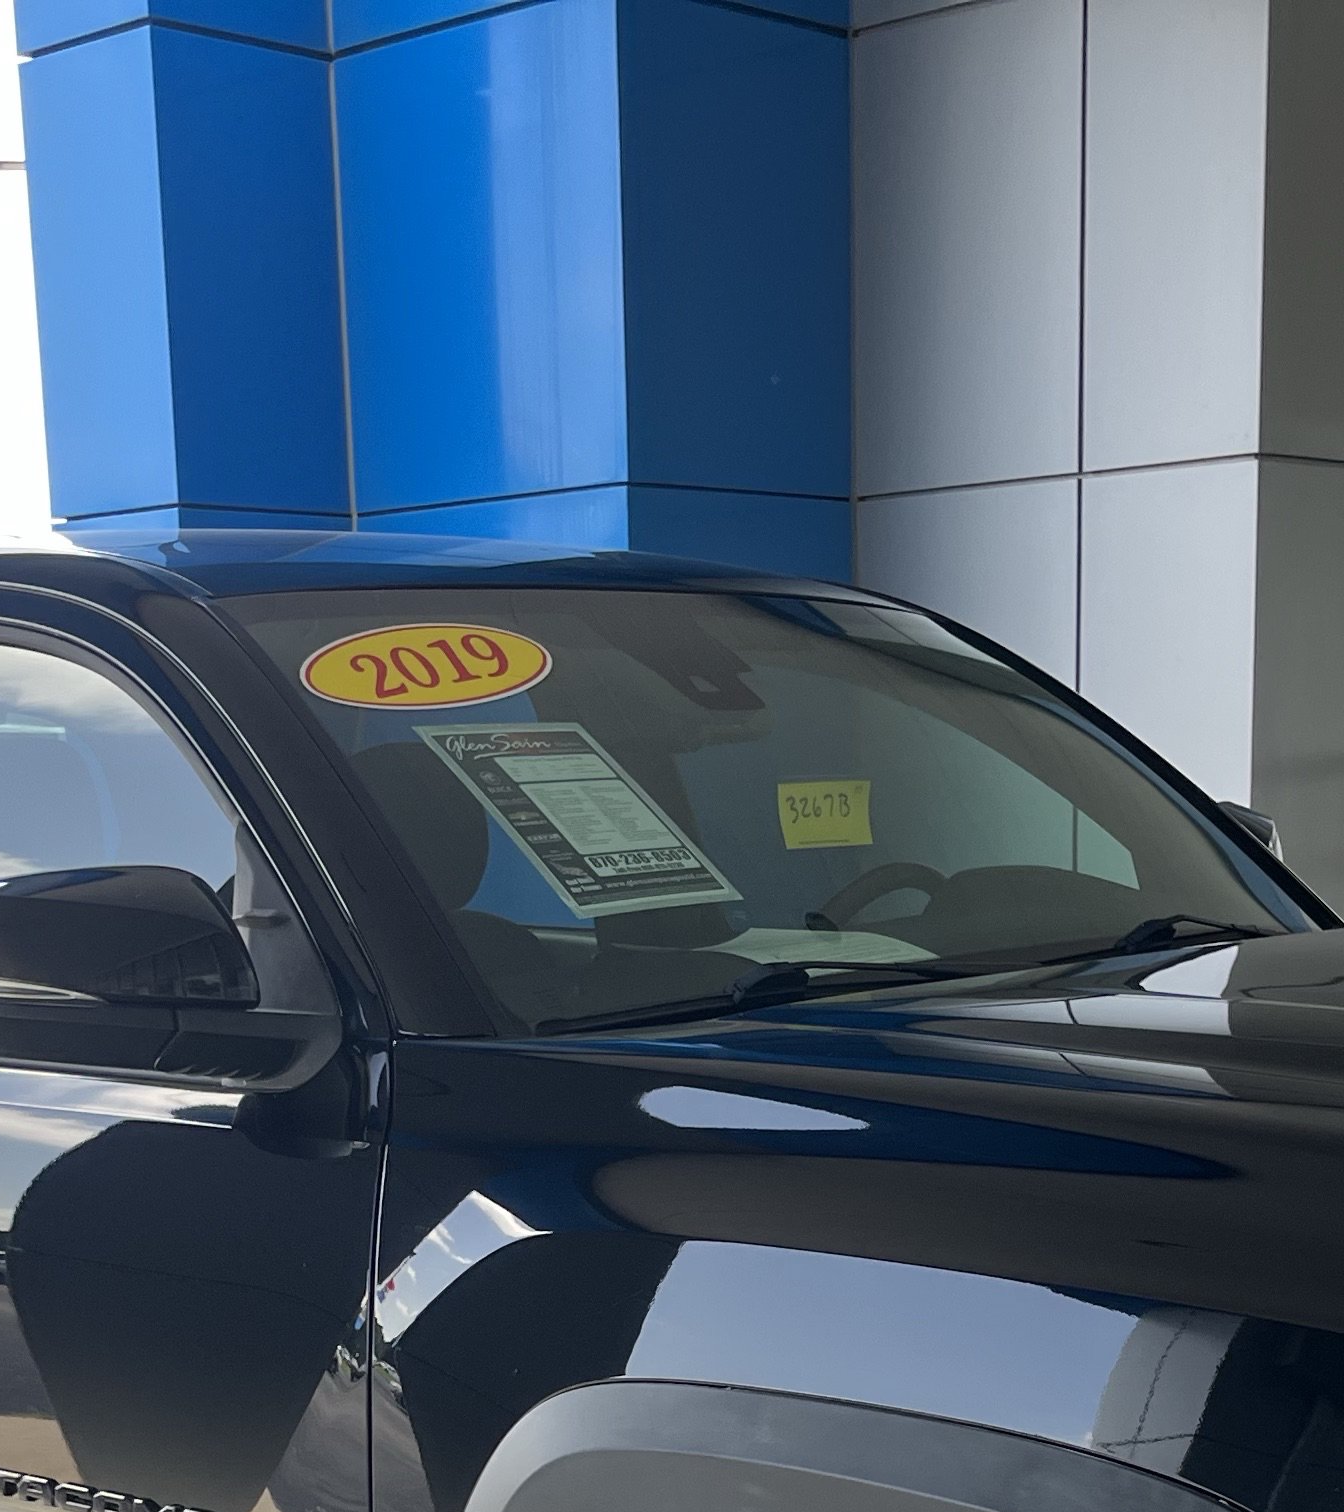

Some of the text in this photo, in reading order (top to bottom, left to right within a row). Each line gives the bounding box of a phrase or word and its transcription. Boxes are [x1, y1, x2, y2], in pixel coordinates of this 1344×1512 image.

[349, 633, 510, 699] 2019
[445, 735, 496, 761] Glen
[490, 733, 552, 752] Sain
